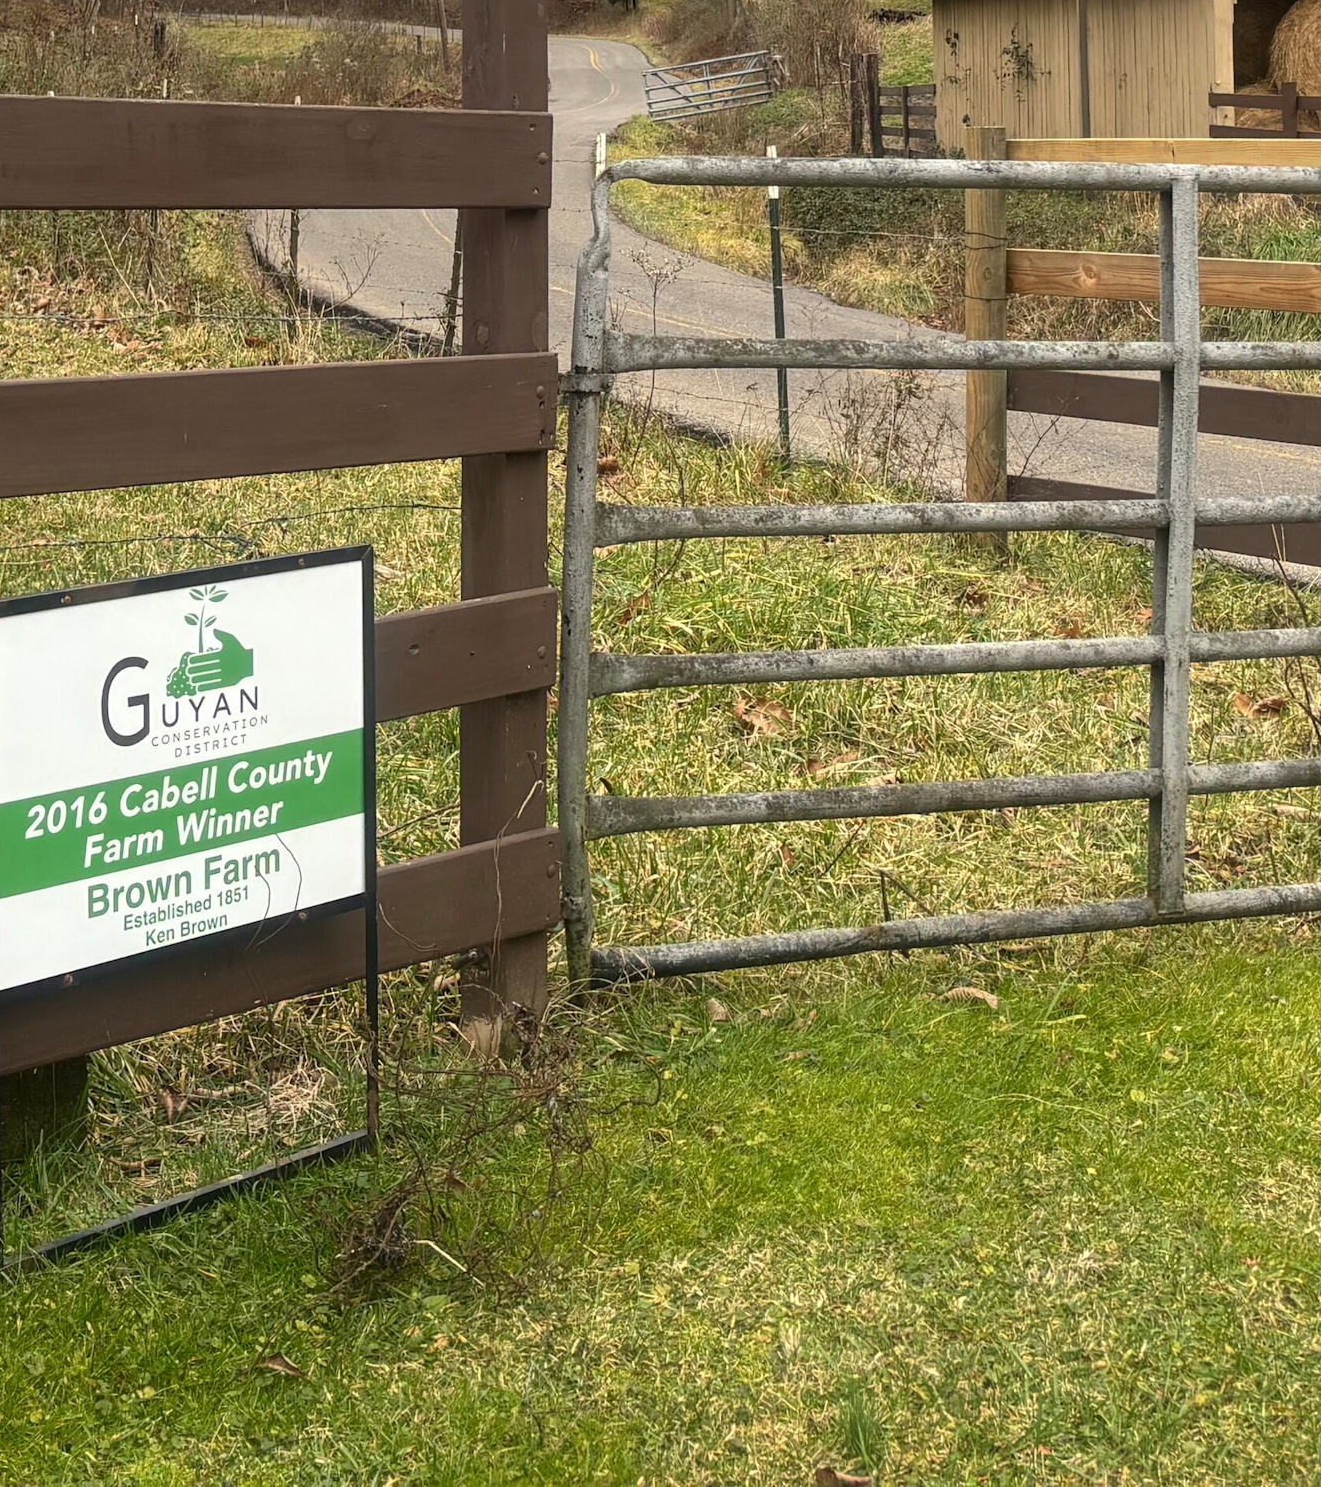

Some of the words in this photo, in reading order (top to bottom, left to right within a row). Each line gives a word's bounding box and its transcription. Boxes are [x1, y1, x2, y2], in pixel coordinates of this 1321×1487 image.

[101, 656, 258, 747] GUYAN
[151, 714, 268, 747] CONSERVATION
[174, 734, 247, 758] DISTRICT
[24, 790, 107, 839] 2016
[120, 766, 217, 818] Cabell
[227, 749, 333, 794] County
[82, 828, 164, 868] Farm
[176, 798, 284, 846] Winner
[87, 870, 192, 919] Brown
[204, 848, 280, 889] Farm
[123, 898, 212, 930] Established
[217, 887, 248, 905] 1851
[146, 928, 176, 946] Ken
[180, 915, 227, 938] Brown
